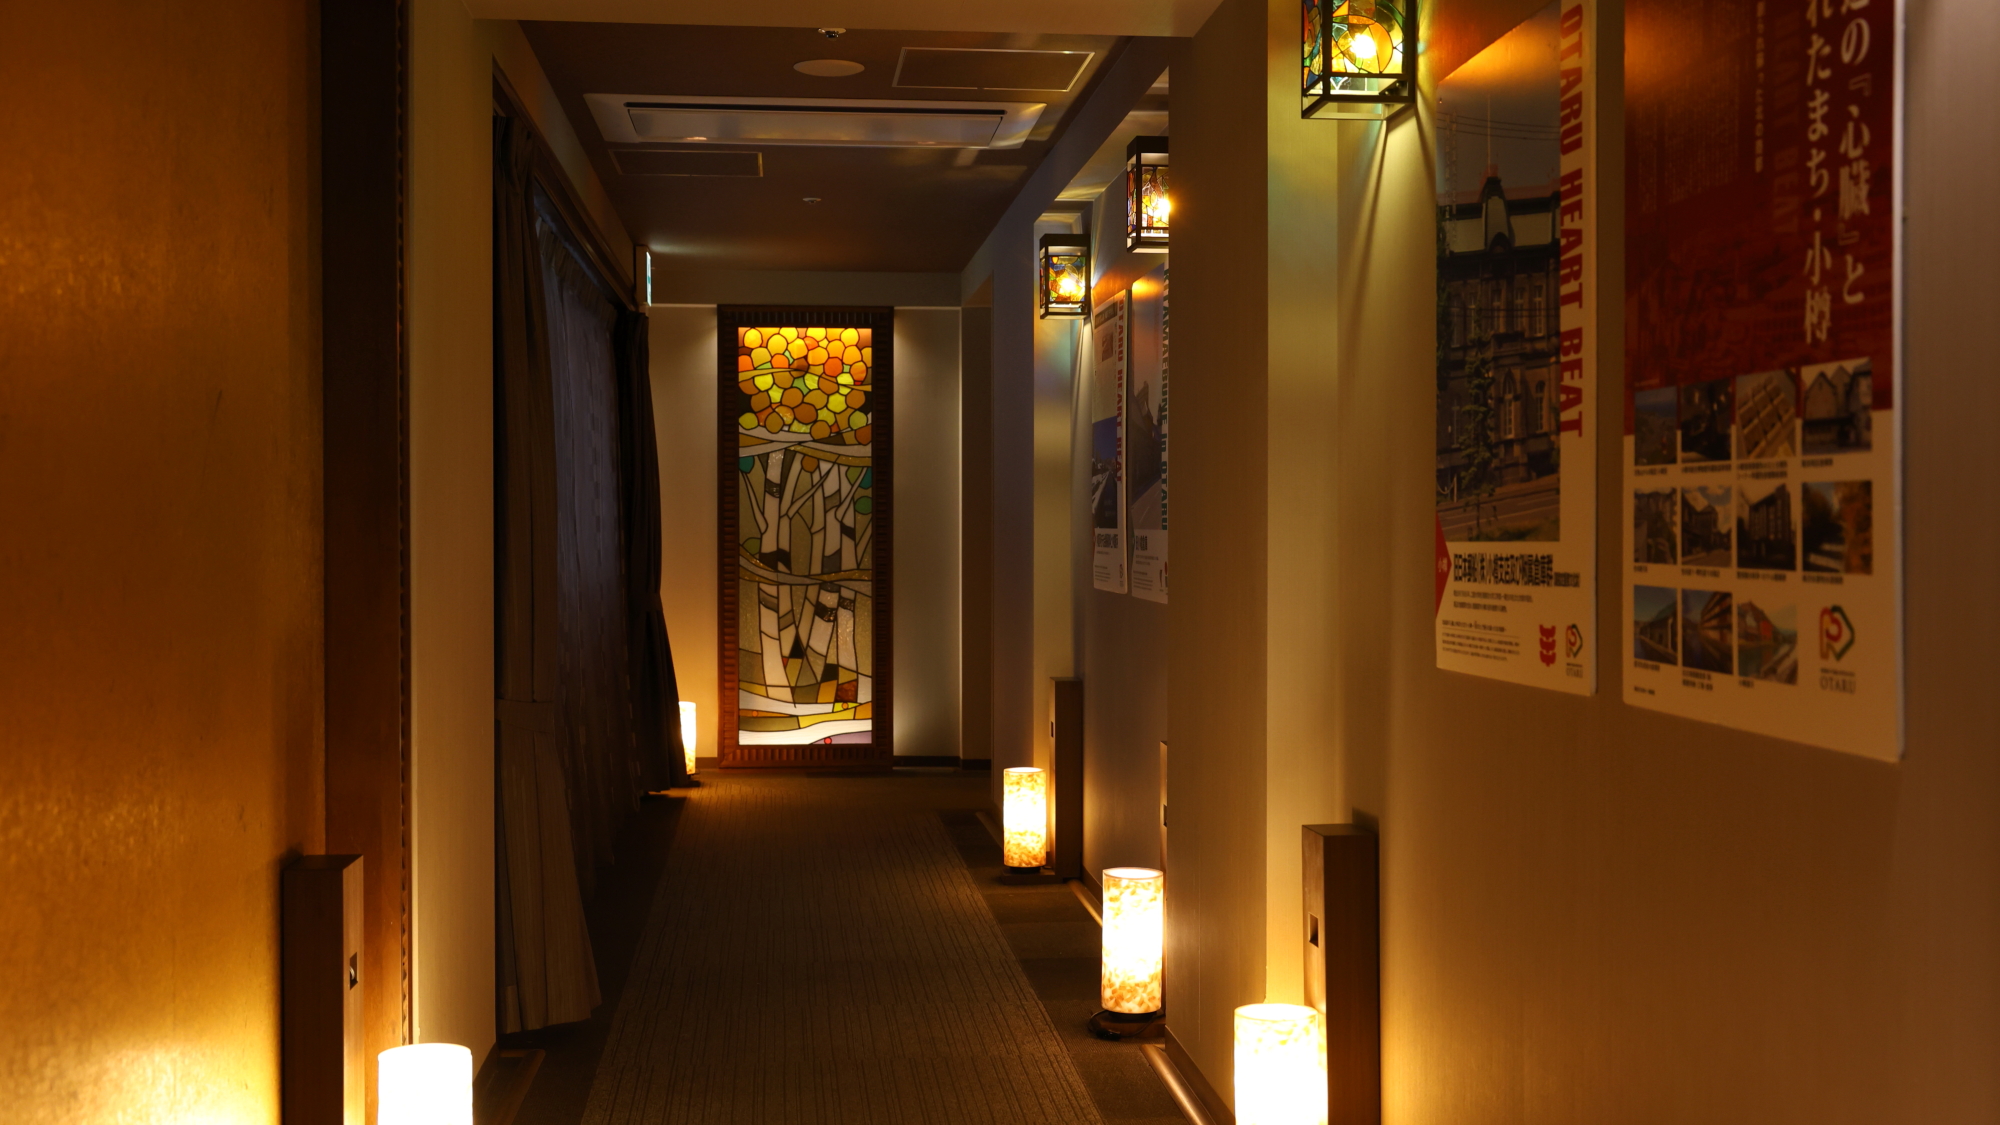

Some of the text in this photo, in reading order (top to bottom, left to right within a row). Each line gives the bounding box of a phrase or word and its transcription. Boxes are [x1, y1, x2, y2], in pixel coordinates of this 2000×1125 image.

[1772, 145, 1799, 234] BEAT
[1838, 0, 1873, 304] の『心臓』と
[1560, 4, 1583, 438] OTARU HEART BEAT
[1117, 299, 1125, 362] OTARU
[1818, 675, 1857, 695] OTARU
